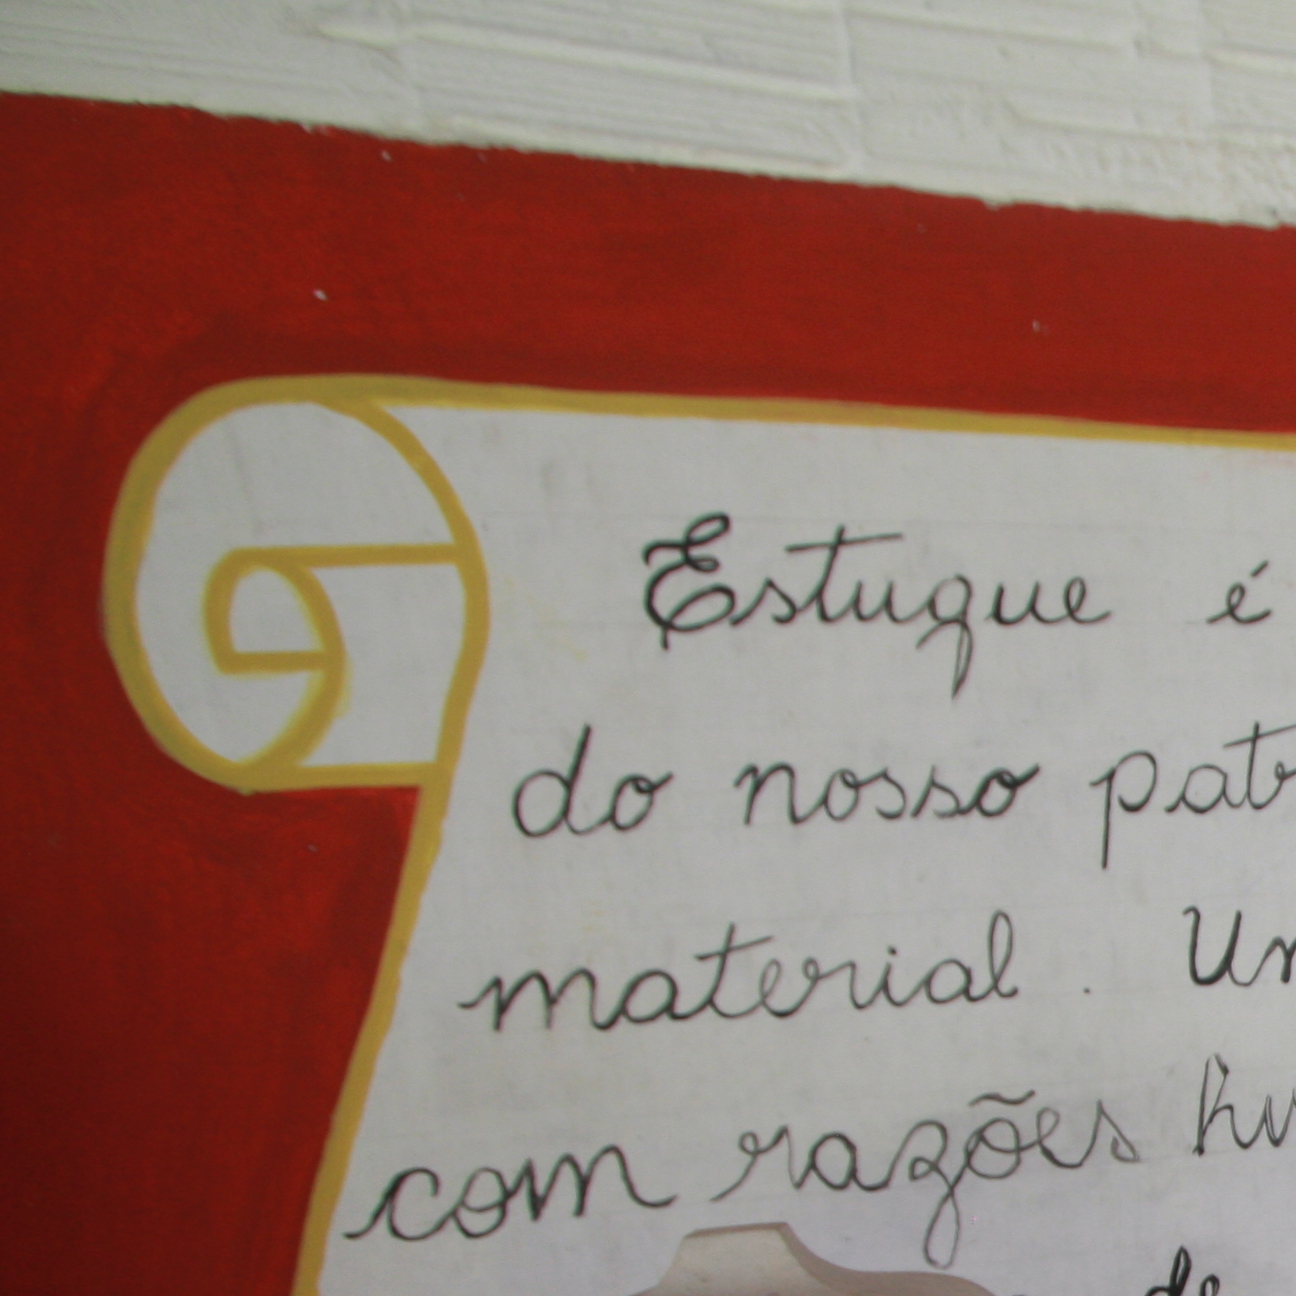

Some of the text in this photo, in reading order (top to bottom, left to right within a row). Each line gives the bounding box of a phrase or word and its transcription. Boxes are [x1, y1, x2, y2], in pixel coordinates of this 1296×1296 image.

[641, 511, 1111, 699] Estuque
[1206, 560, 1273, 627] é
[511, 724, 674, 839] do
[734, 762, 1041, 826] nosso
[344, 1144, 677, 1242] com
[709, 1089, 1140, 1266] razões
